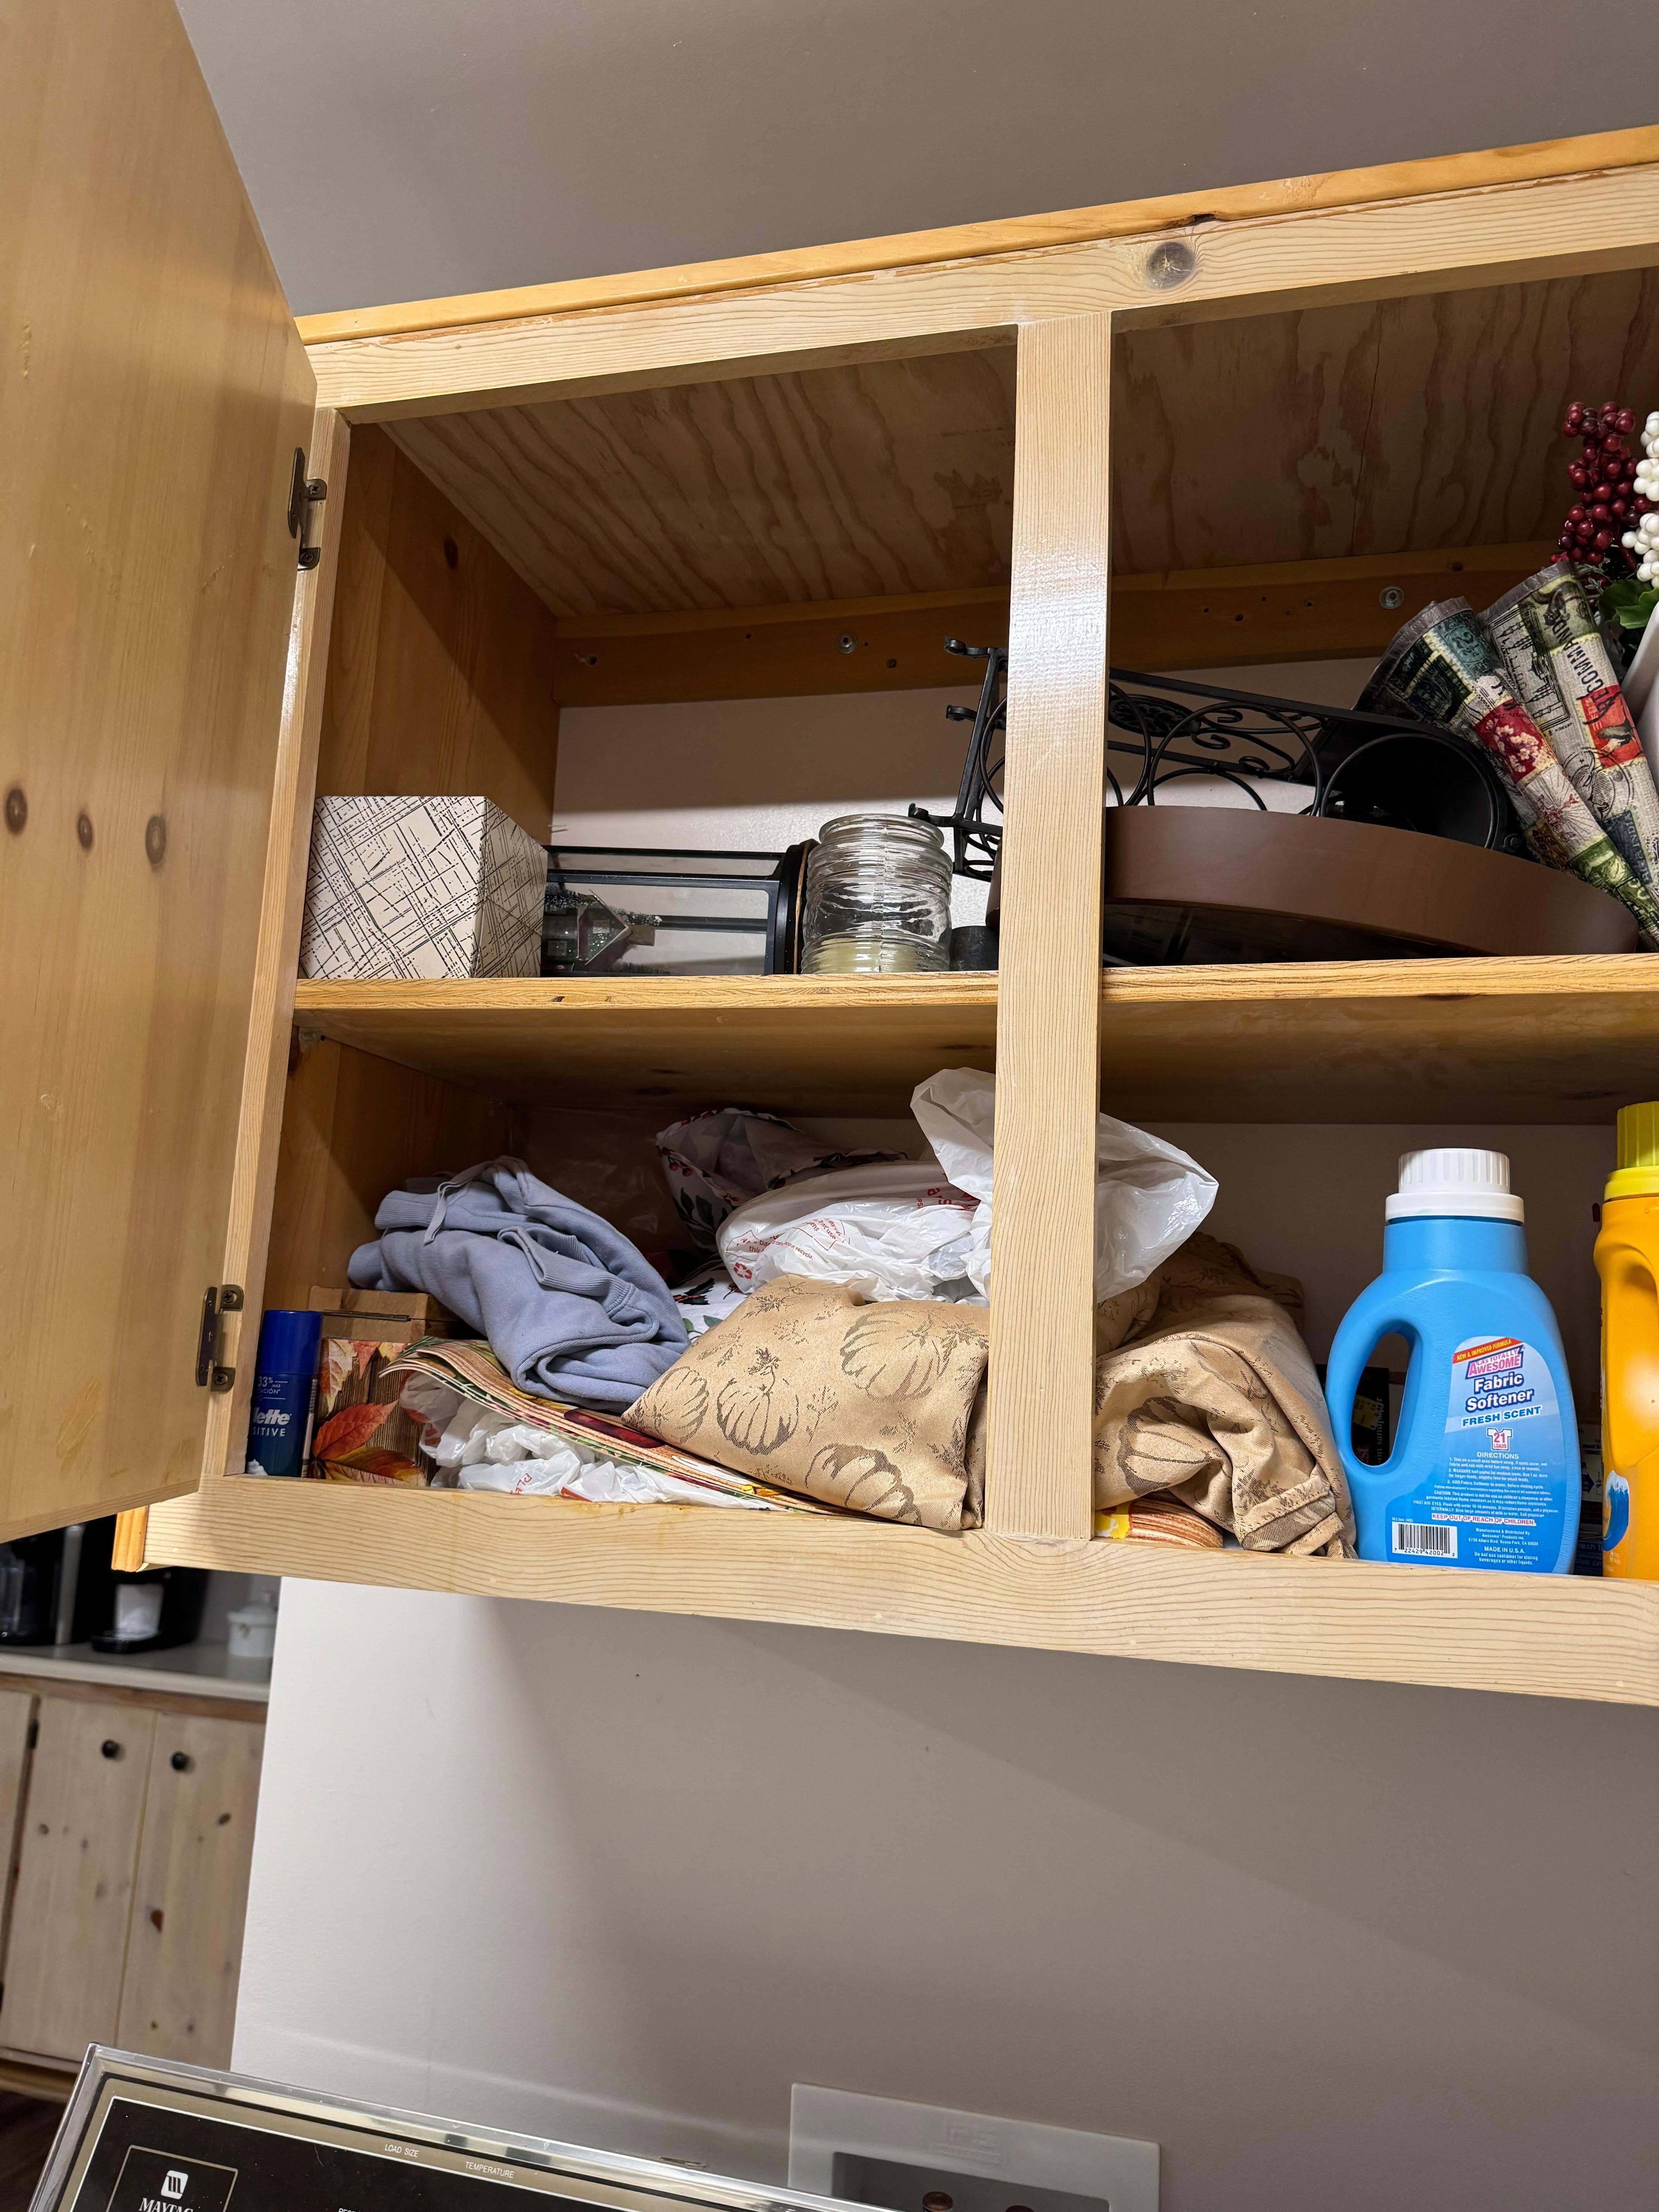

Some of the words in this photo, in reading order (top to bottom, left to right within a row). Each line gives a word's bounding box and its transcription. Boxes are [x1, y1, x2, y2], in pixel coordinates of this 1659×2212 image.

[1626, 813, 1639, 847] INDIA
[1472, 1346, 1492, 1356] IMPROVED
[1493, 1338, 1511, 1349] FORMULA
[1490, 1348, 1519, 1362] TOTALLY
[1468, 1355, 1520, 1376] AWESOME
[1475, 1373, 1523, 1393] Fabric
[1467, 1389, 1533, 1412] Softener
[1463, 1413, 1500, 1427] FRESH
[1504, 1406, 1541, 1419] SCENT
[1494, 1432, 1505, 1443] 21
[385, 2144, 402, 2153] LOAD
[404, 2148, 419, 2157] SIZE
[465, 2161, 515, 2179] TEMPERATURE
